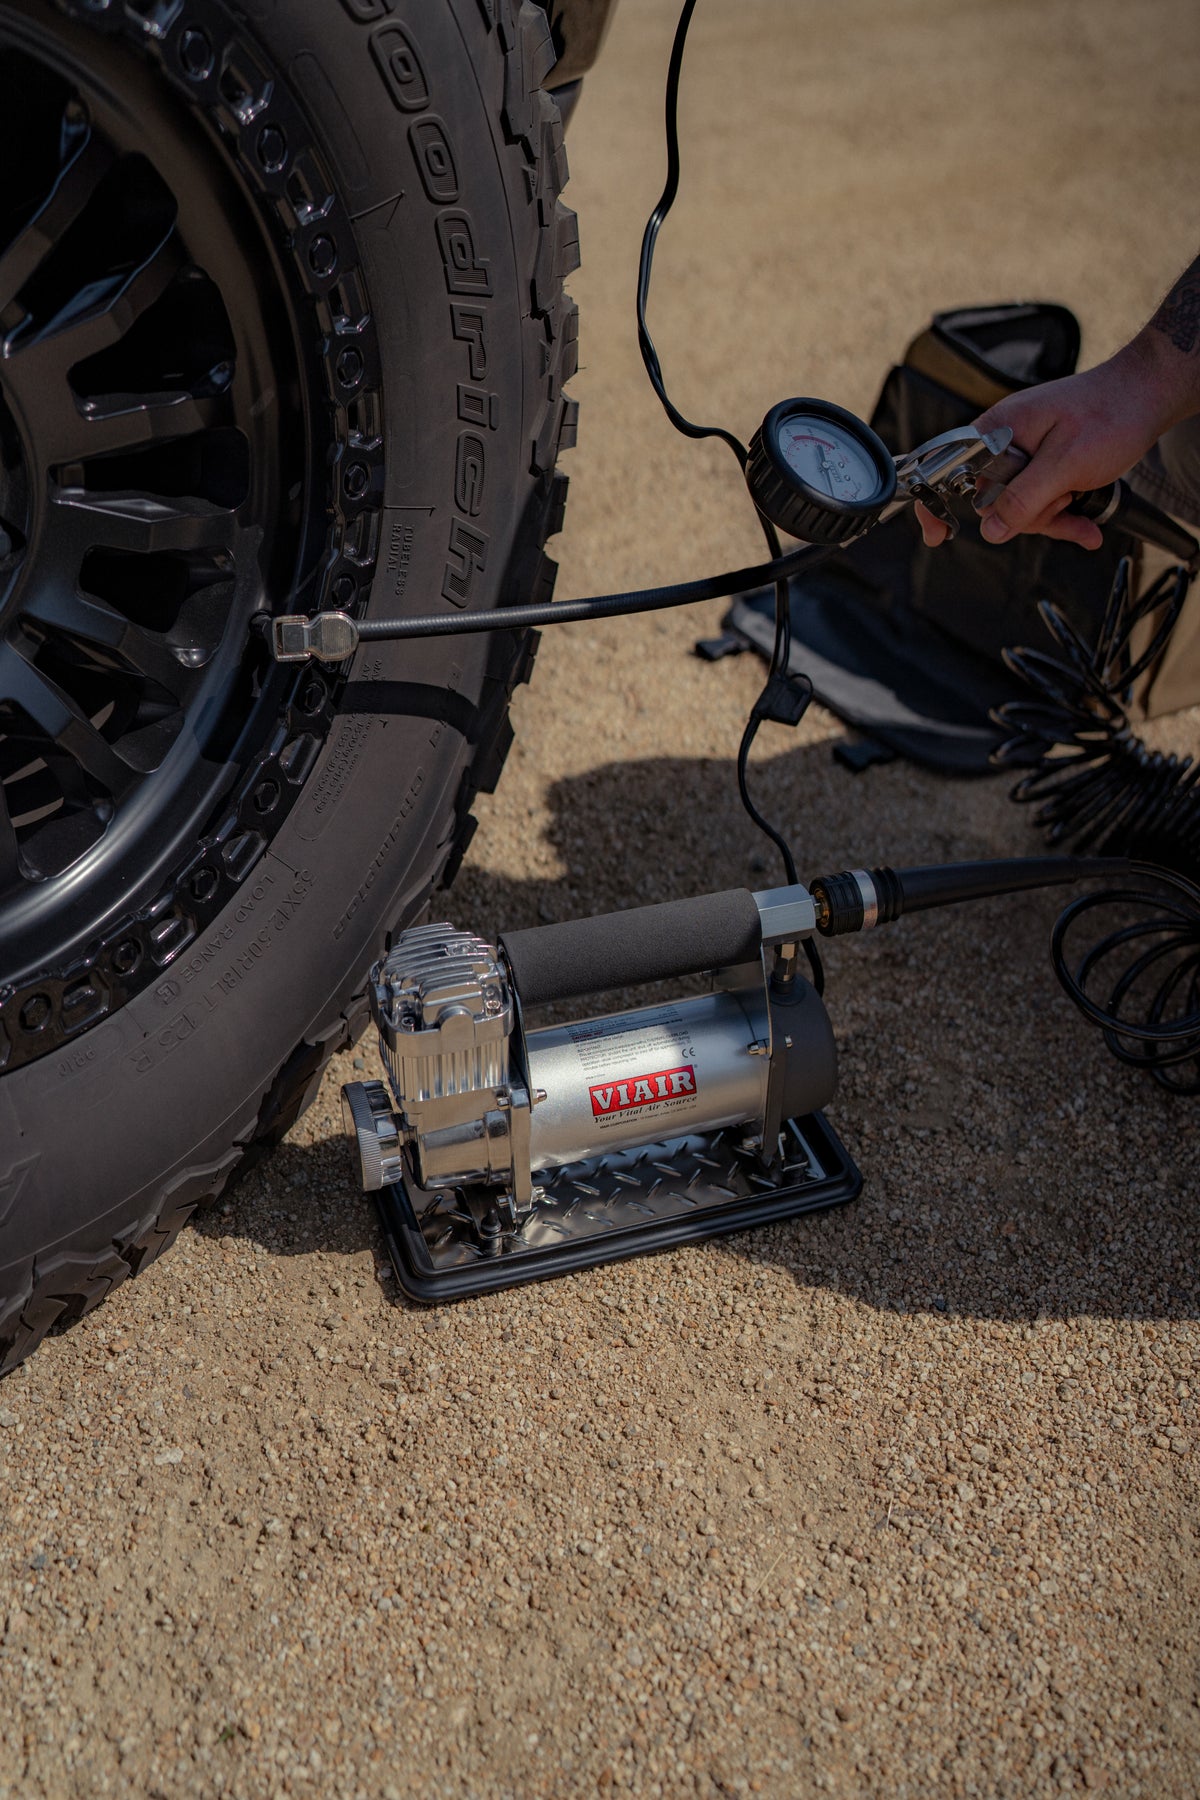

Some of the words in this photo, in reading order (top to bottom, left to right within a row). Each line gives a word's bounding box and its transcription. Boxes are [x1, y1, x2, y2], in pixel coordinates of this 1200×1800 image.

[338, 0, 498, 608] oodrich
[387, 523, 402, 573] RADIAL
[234, 874, 275, 923] LOAD
[180, 923, 236, 983] RANGE
[592, 1070, 695, 1111] VIAIR
[594, 1114, 617, 1124] Your
[619, 1106, 643, 1119] Vital
[645, 1103, 661, 1113] Air
[663, 1096, 698, 1108] Source
